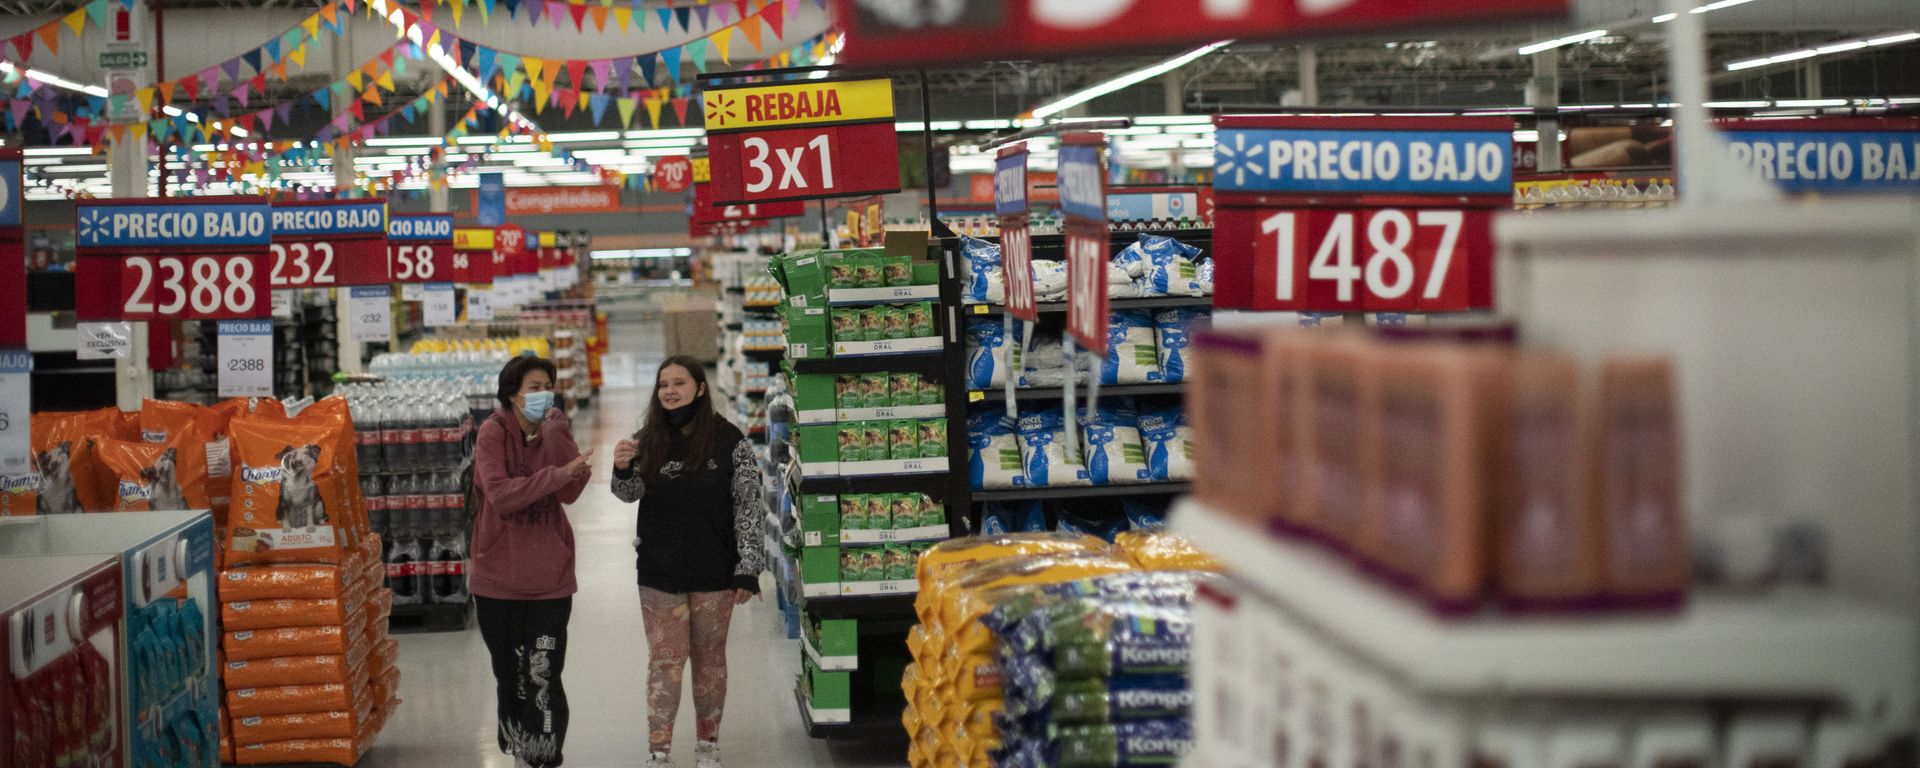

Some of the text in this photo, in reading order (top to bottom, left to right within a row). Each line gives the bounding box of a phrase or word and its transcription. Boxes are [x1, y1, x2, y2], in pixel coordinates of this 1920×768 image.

[745, 89, 841, 122] REBAJA
[744, 134, 833, 193] 3x1
[1268, 140, 1503, 182] PRECIO BAJO
[506, 190, 609, 211] Congelados
[114, 212, 264, 238] PRECIO BAJO
[272, 208, 380, 230] PRECIO BAJO
[390, 220, 450, 236] CIO BAJO
[270, 242, 335, 285] 232
[1261, 209, 1464, 301] 1487
[124, 256, 256, 315] 2388
[220, 323, 271, 333] PRECIO BAJO
[281, 534, 312, 542] ADULTO
